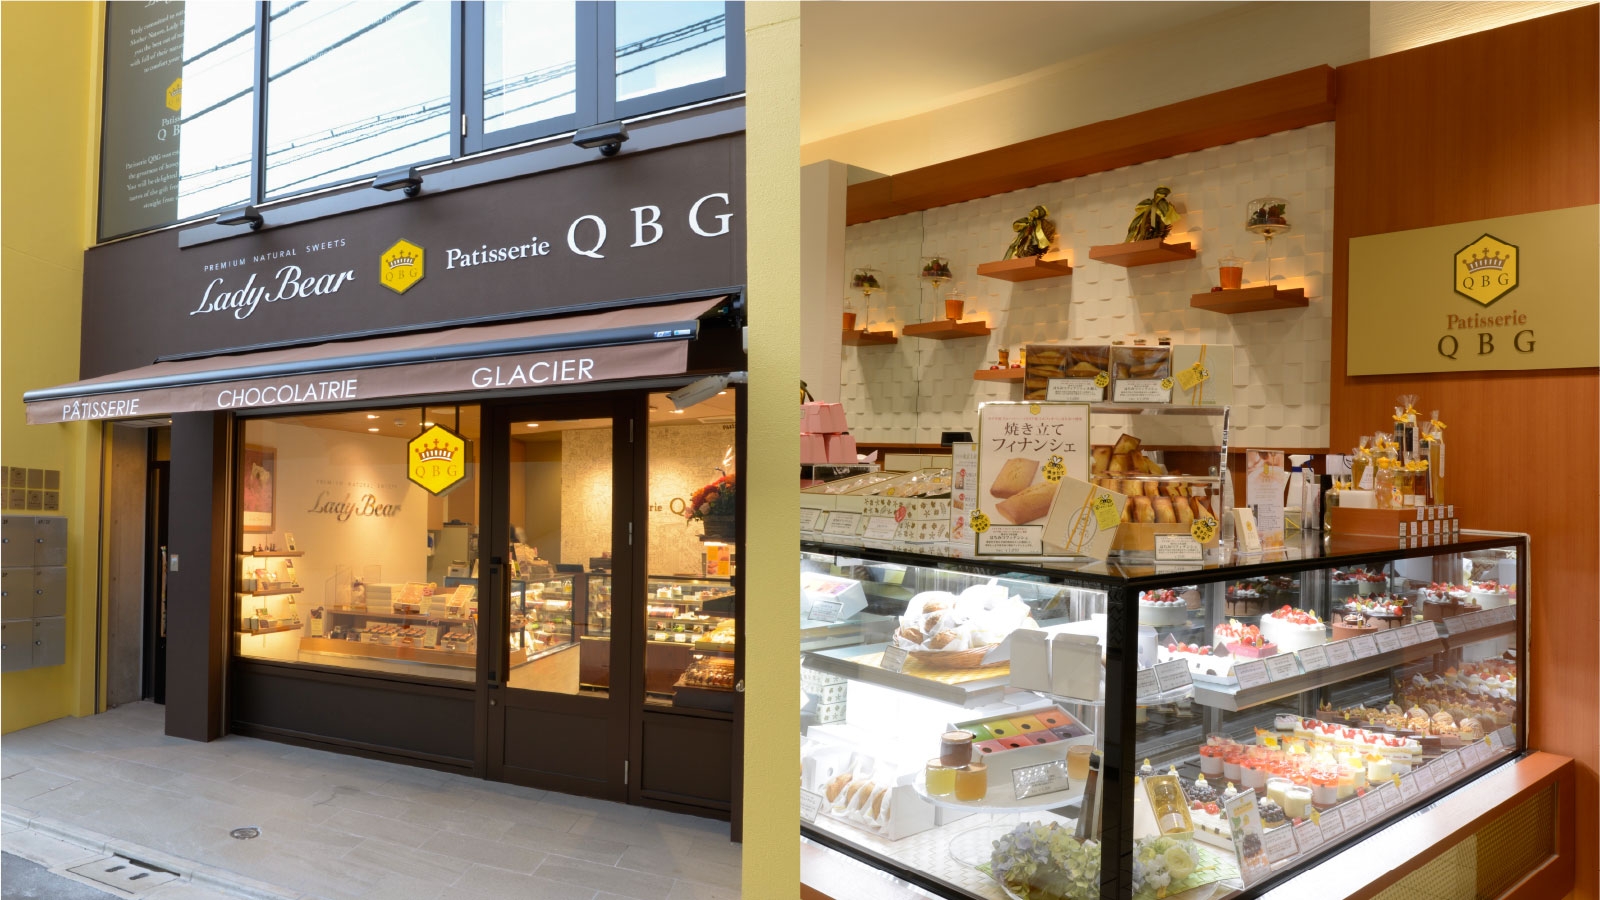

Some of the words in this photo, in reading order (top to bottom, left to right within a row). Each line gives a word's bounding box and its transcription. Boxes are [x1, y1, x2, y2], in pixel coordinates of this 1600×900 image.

[204, 258, 246, 272] PREMIUM
[253, 248, 297, 263] NATURAL
[306, 238, 346, 253] SWEETS
[445, 236, 550, 270] Patisserie
[189, 273, 265, 320] Lady
[264, 265, 356, 302] Bear
[1447, 309, 1527, 330] Patisserie
[471, 358, 595, 388] GLACIER
[217, 379, 358, 408] CHOCOLATRIE
[62, 398, 140, 421] PÂTISSERIE
[1004, 422, 1064, 436] 焼き立て
[992, 437, 1076, 453] フィナンシェ
[307, 490, 356, 522] Lady
[355, 493, 402, 517] Bear
